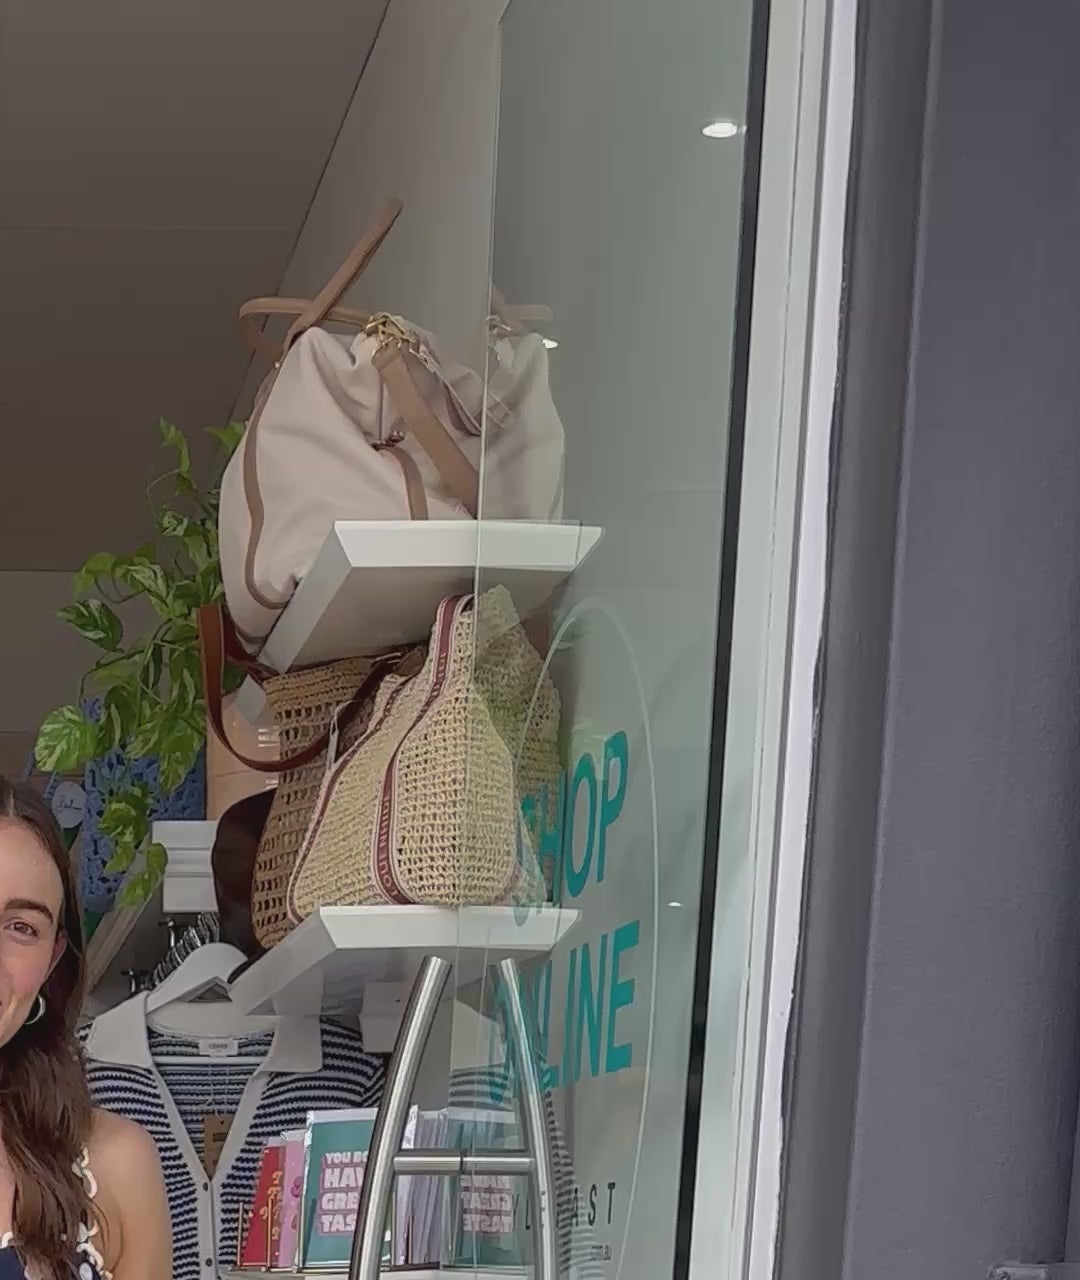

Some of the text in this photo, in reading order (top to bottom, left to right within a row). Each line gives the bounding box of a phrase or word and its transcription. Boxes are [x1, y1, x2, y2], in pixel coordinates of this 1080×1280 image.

[324, 1167, 365, 1189] HAV
[322, 1192, 360, 1210] GRE
[321, 1214, 357, 1232] TAS
